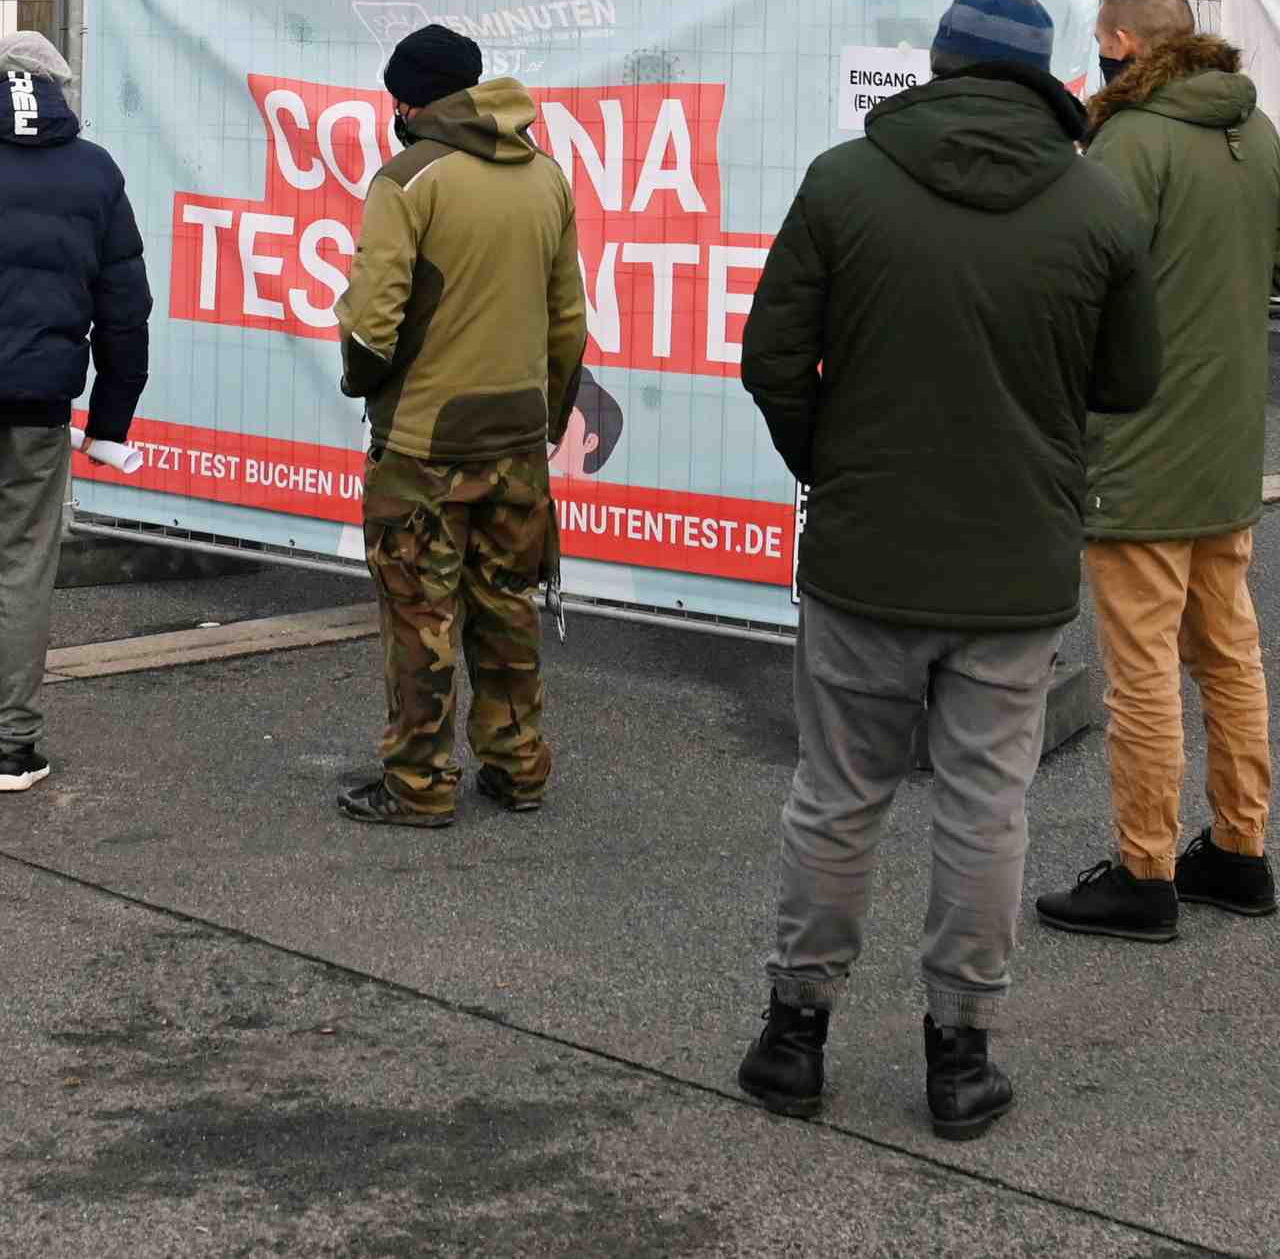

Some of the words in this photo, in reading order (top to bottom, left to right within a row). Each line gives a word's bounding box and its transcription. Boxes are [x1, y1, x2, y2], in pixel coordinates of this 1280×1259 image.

[850, 70, 917, 88] EINGANG
[264, 89, 708, 213] CONA
[187, 450, 240, 481] TEST
[246, 458, 333, 495] BUCHEN
